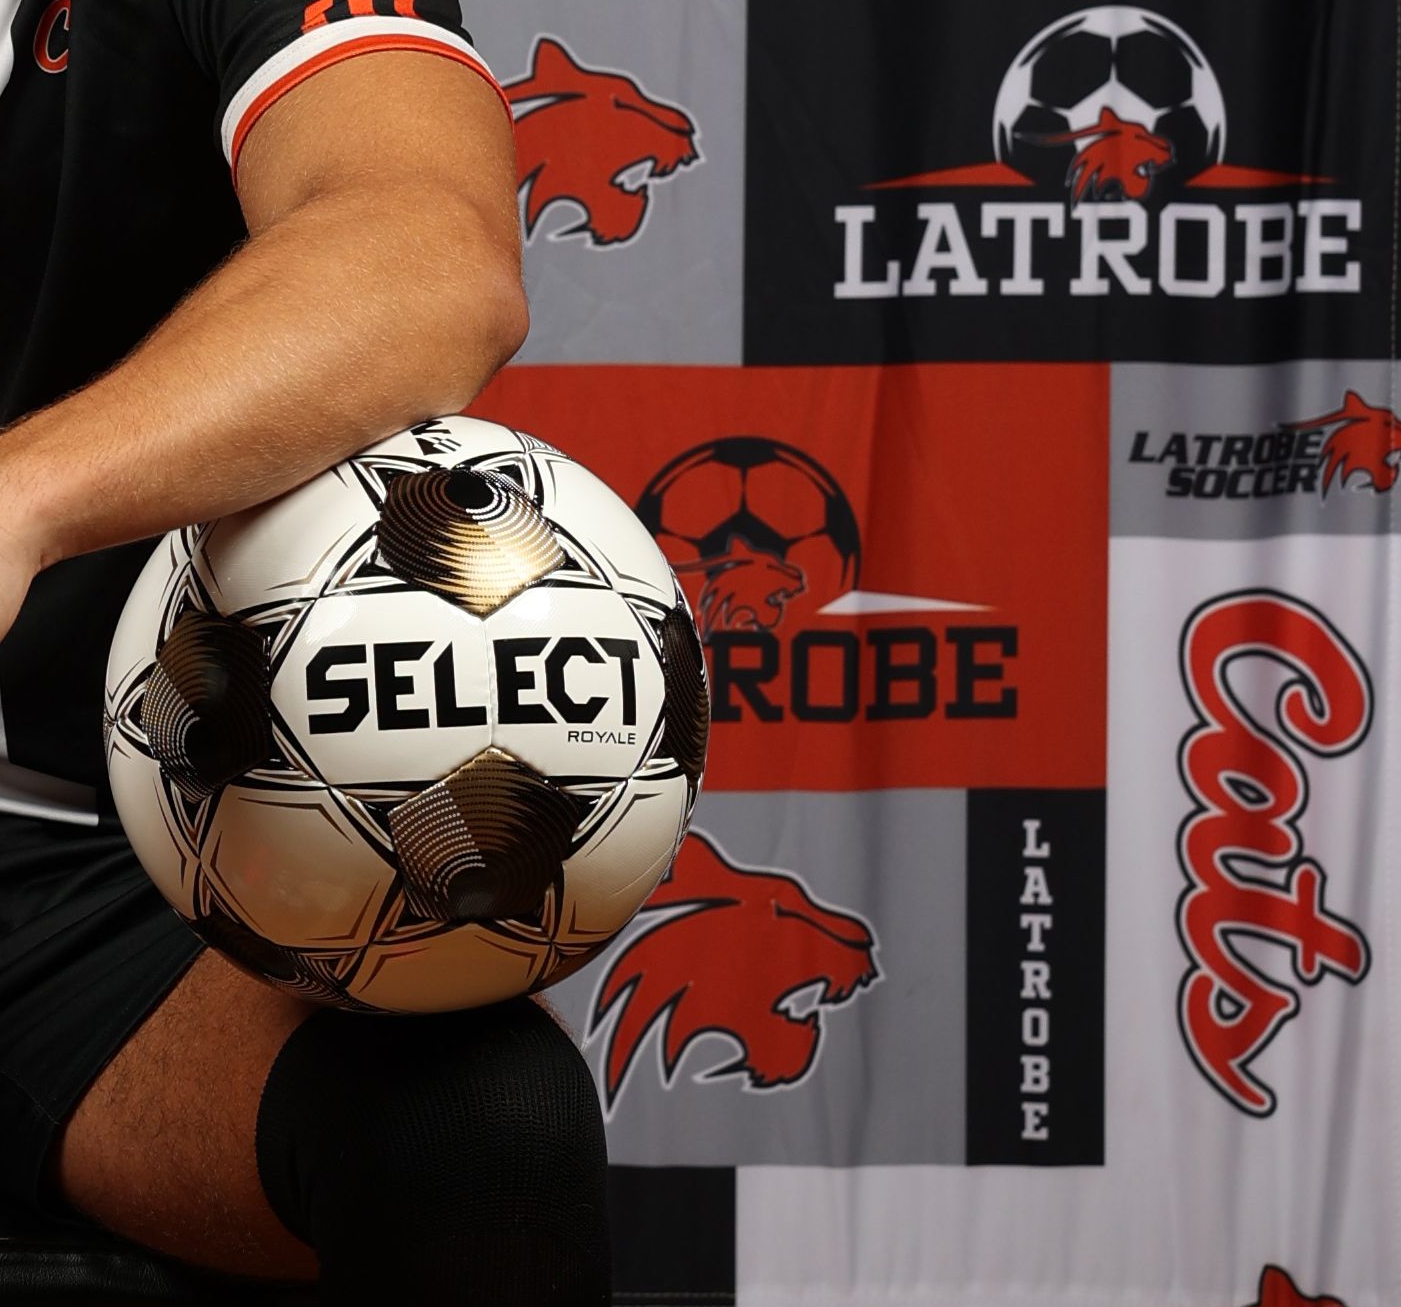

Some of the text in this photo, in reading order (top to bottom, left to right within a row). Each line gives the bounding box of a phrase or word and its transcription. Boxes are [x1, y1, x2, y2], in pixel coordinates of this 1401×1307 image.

[834, 199, 1362, 299] LATROBE
[1128, 430, 1324, 466] LATROBE
[1165, 463, 1318, 500] SOCCER
[305, 636, 641, 735] SELECT
[709, 626, 1019, 724] ROBE
[567, 730, 638, 745] ROYALE
[1174, 587, 1375, 1118] Cats
[1018, 818, 1053, 1140] LATROBE
